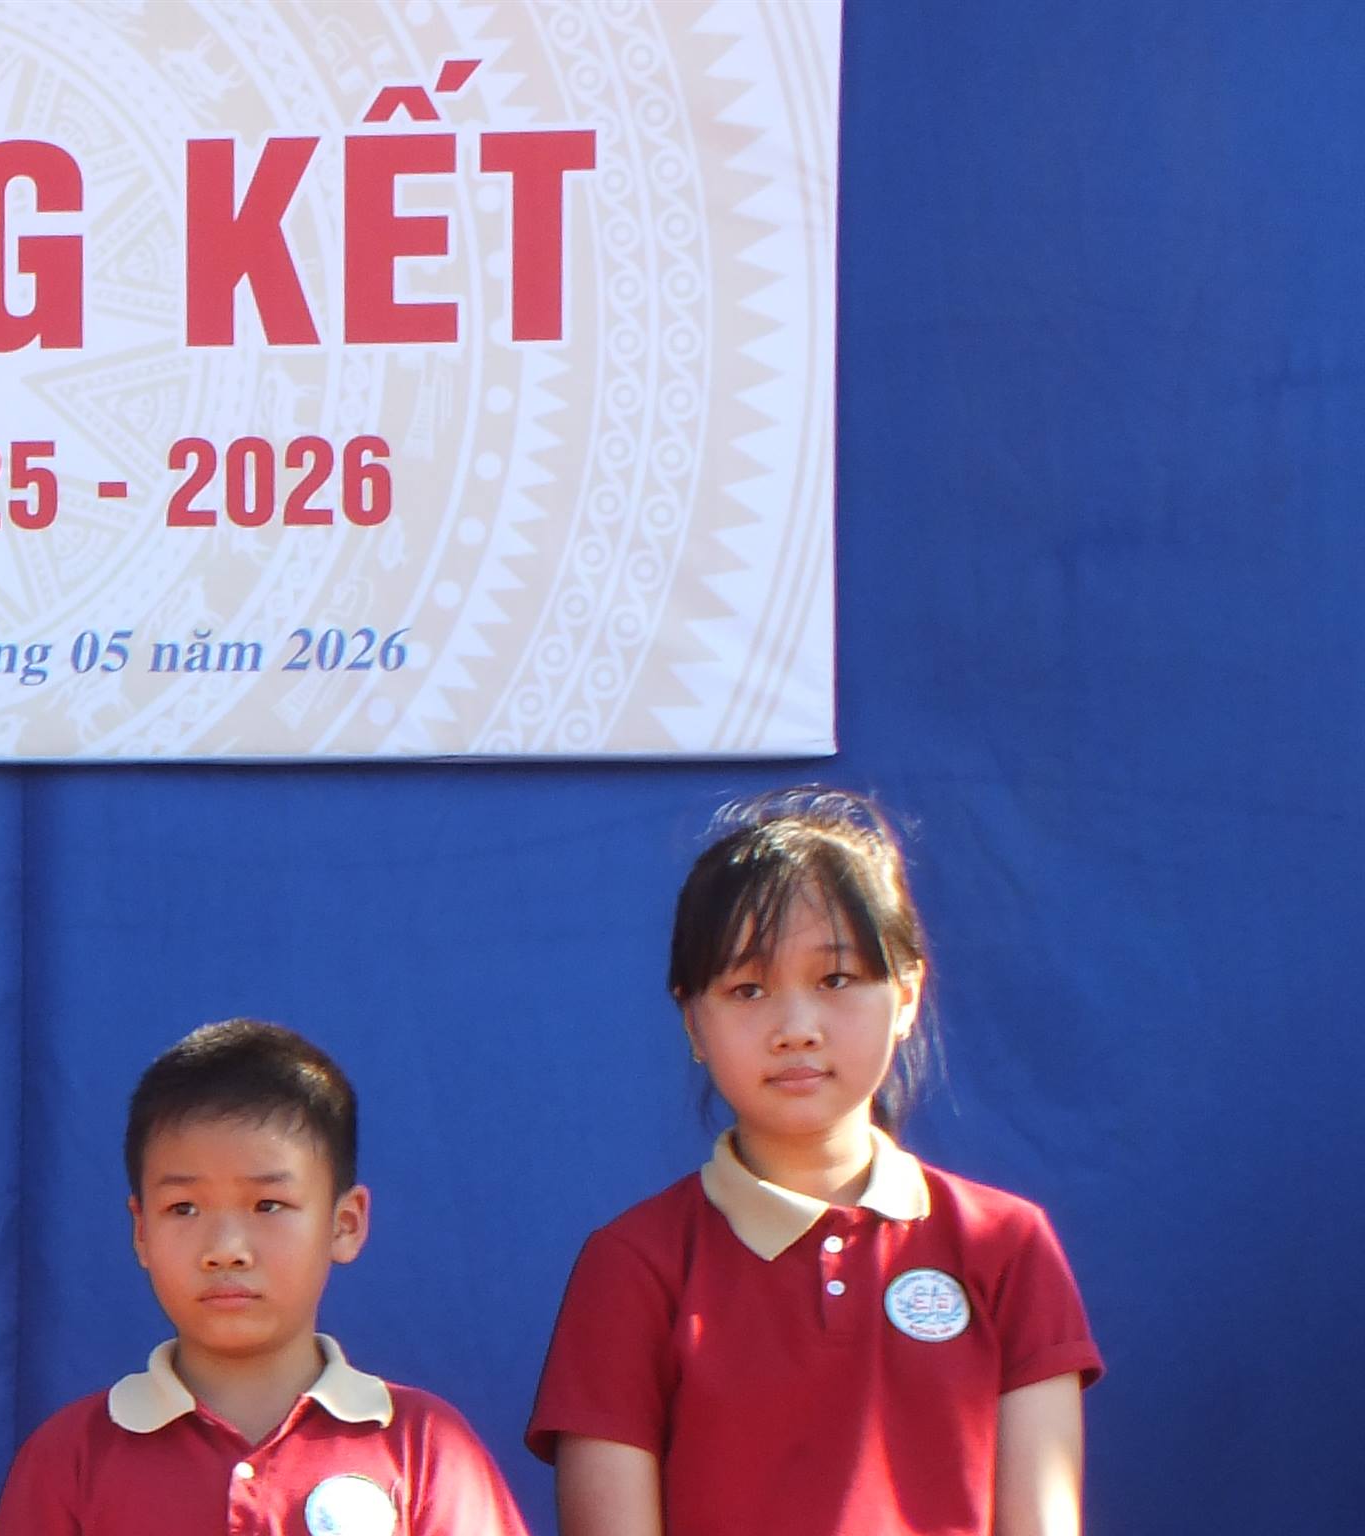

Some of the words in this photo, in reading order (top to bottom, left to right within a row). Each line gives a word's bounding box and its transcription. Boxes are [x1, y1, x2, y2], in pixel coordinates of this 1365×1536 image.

[185, 58, 598, 348] KẾT
[97, 481, 129, 499] -
[166, 434, 393, 528] 2026
[69, 628, 135, 674] 05
[150, 627, 265, 674] năm
[283, 625, 410, 672] 2026
